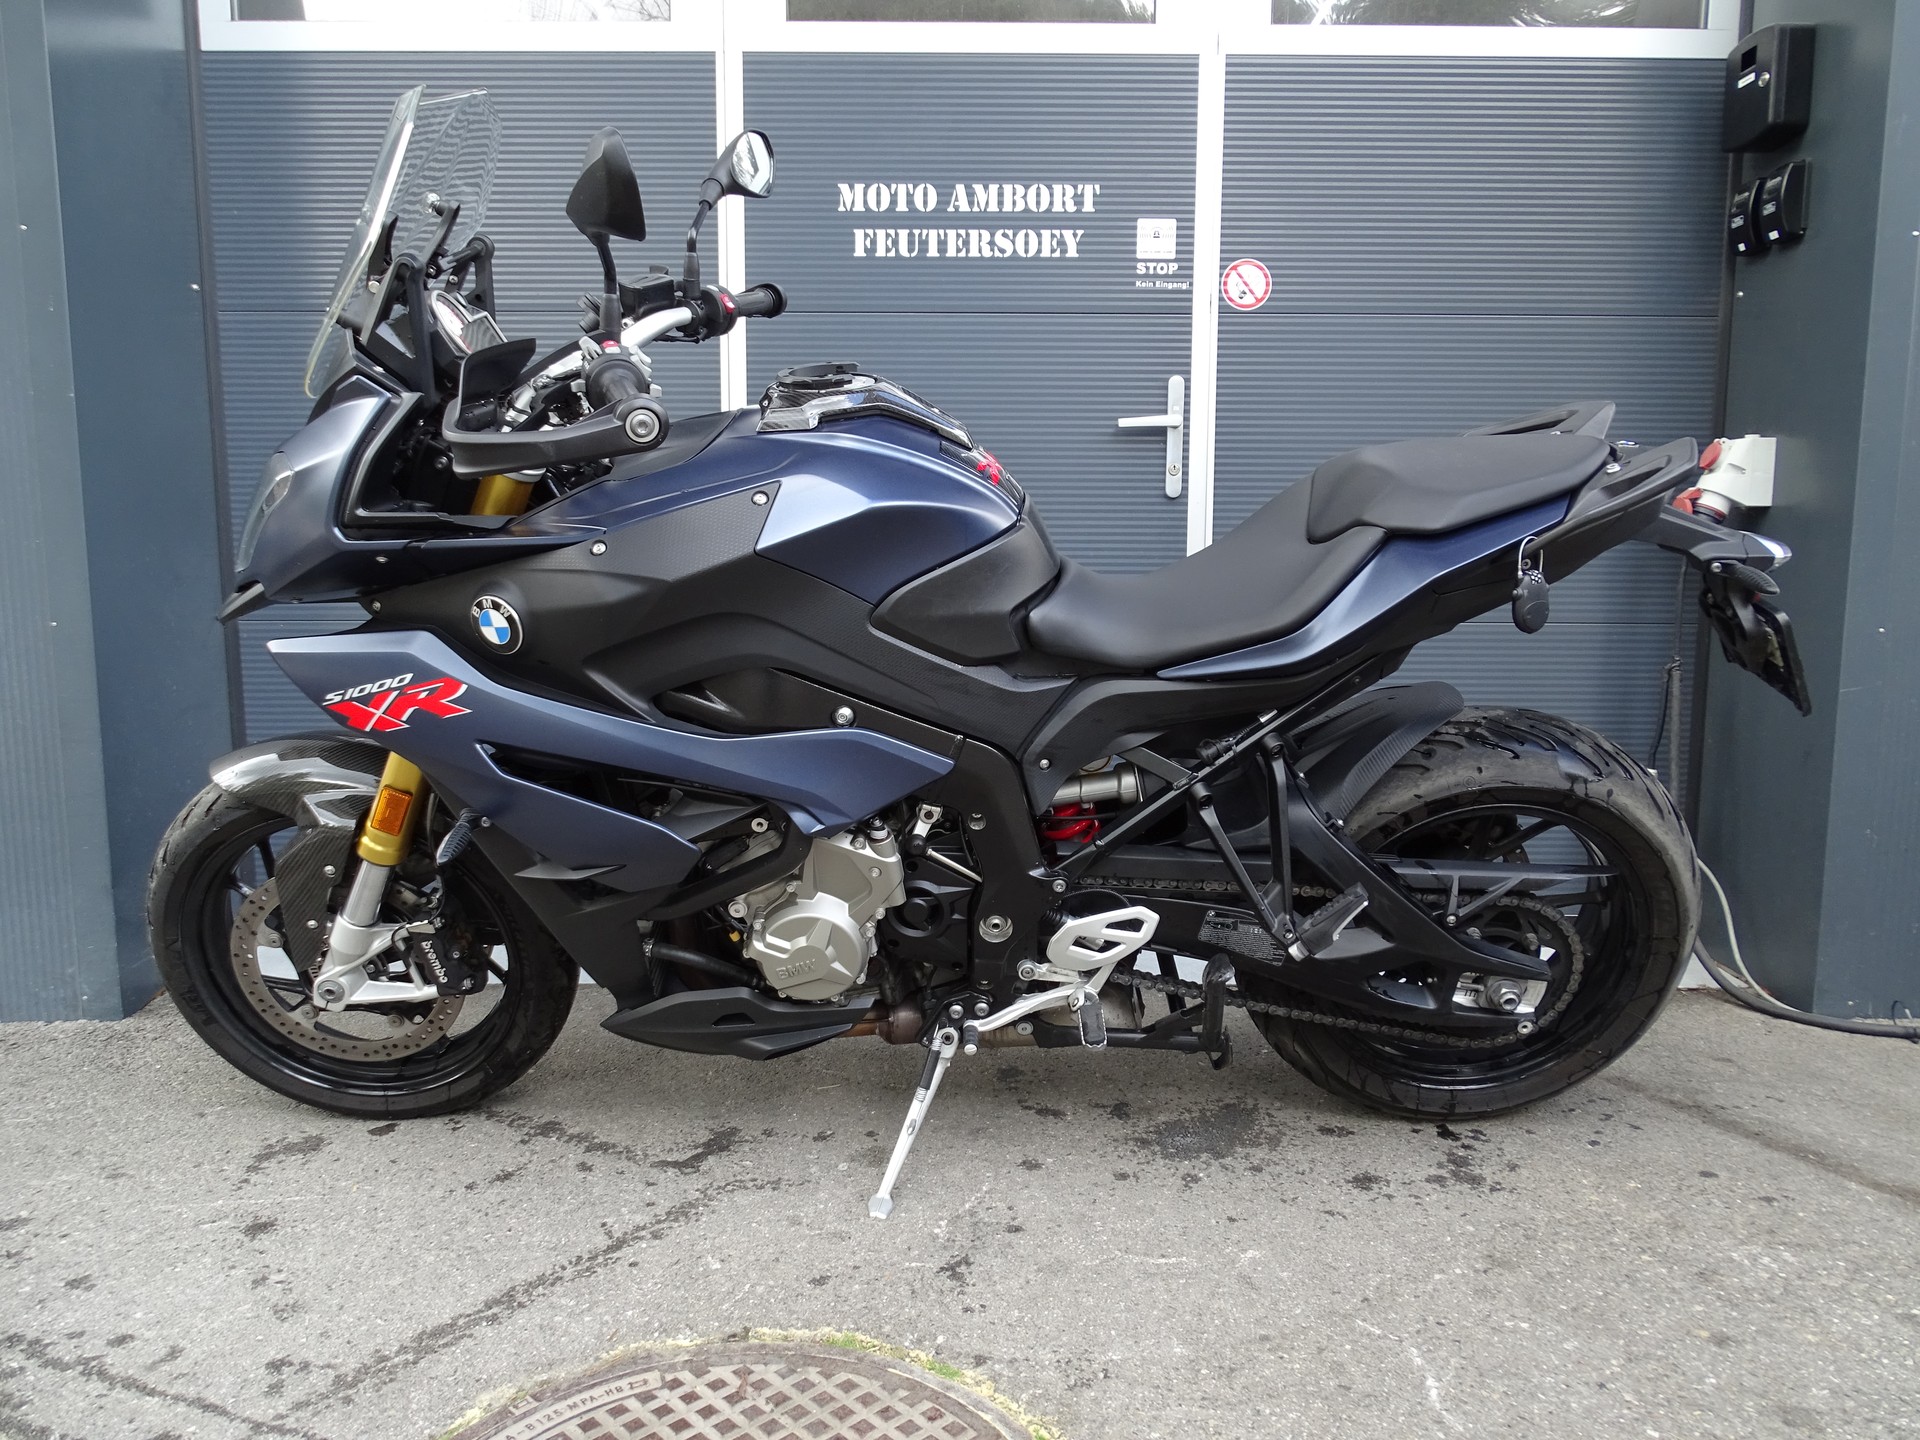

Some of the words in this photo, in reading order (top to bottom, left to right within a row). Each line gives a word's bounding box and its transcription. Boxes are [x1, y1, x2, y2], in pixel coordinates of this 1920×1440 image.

[837, 183, 938, 213] MOTO
[947, 183, 1101, 213] AMBORT
[853, 228, 1085, 258] FEUTERSOEY
[1136, 262, 1178, 274] STOP
[1155, 281, 1189, 289] Eingang!
[472, 599, 511, 618] BMW
[322, 672, 414, 706] S1000
[325, 676, 473, 732] XR
[421, 940, 448, 983] brembo
[776, 958, 816, 980] BMW
